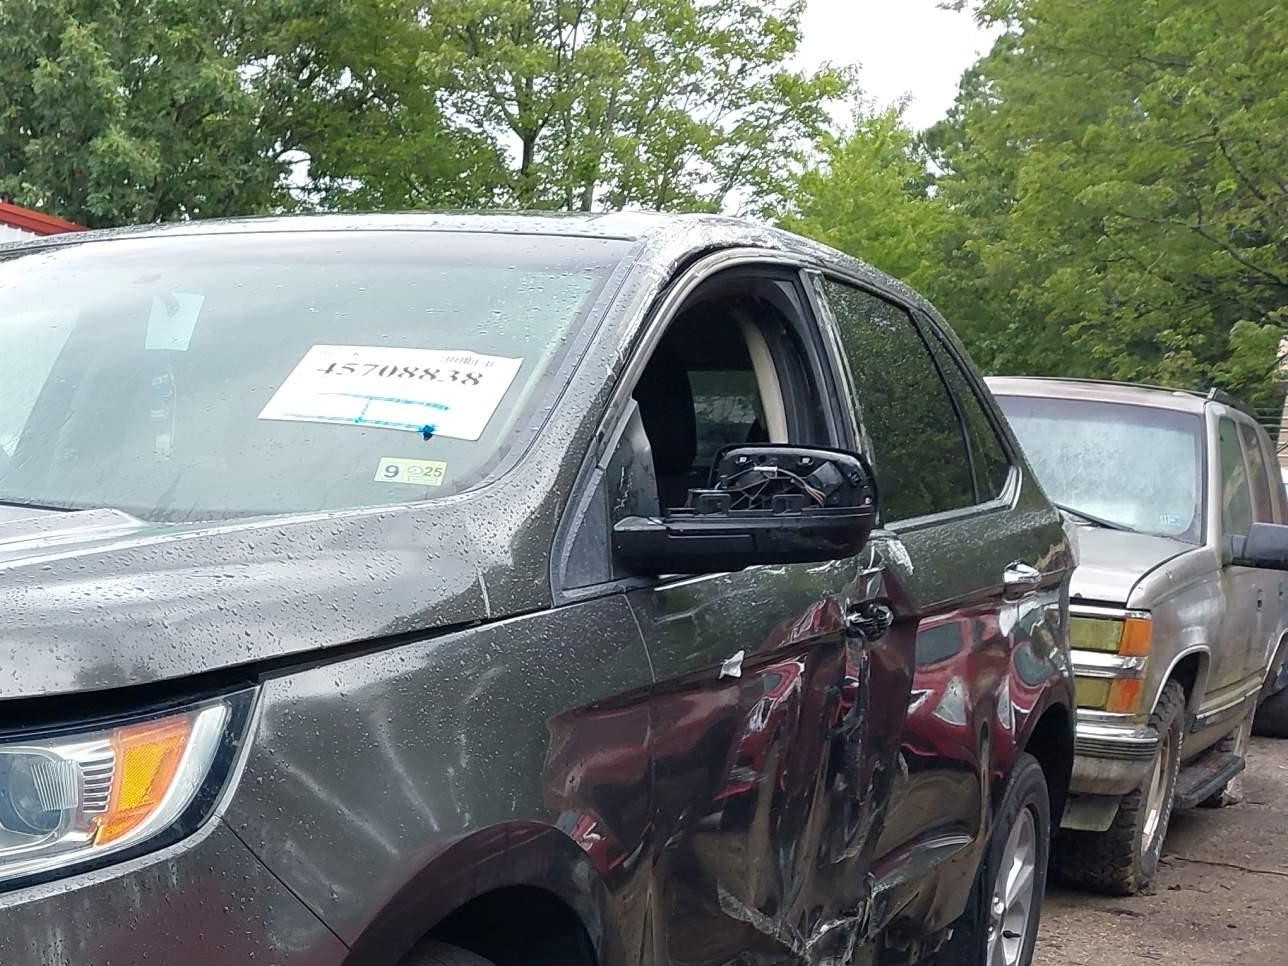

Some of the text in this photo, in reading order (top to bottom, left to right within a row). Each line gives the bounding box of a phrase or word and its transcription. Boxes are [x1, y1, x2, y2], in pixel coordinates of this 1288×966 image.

[316, 362, 483, 386] 45708838
[383, 464, 400, 479] 9
[422, 466, 444, 478] 25
